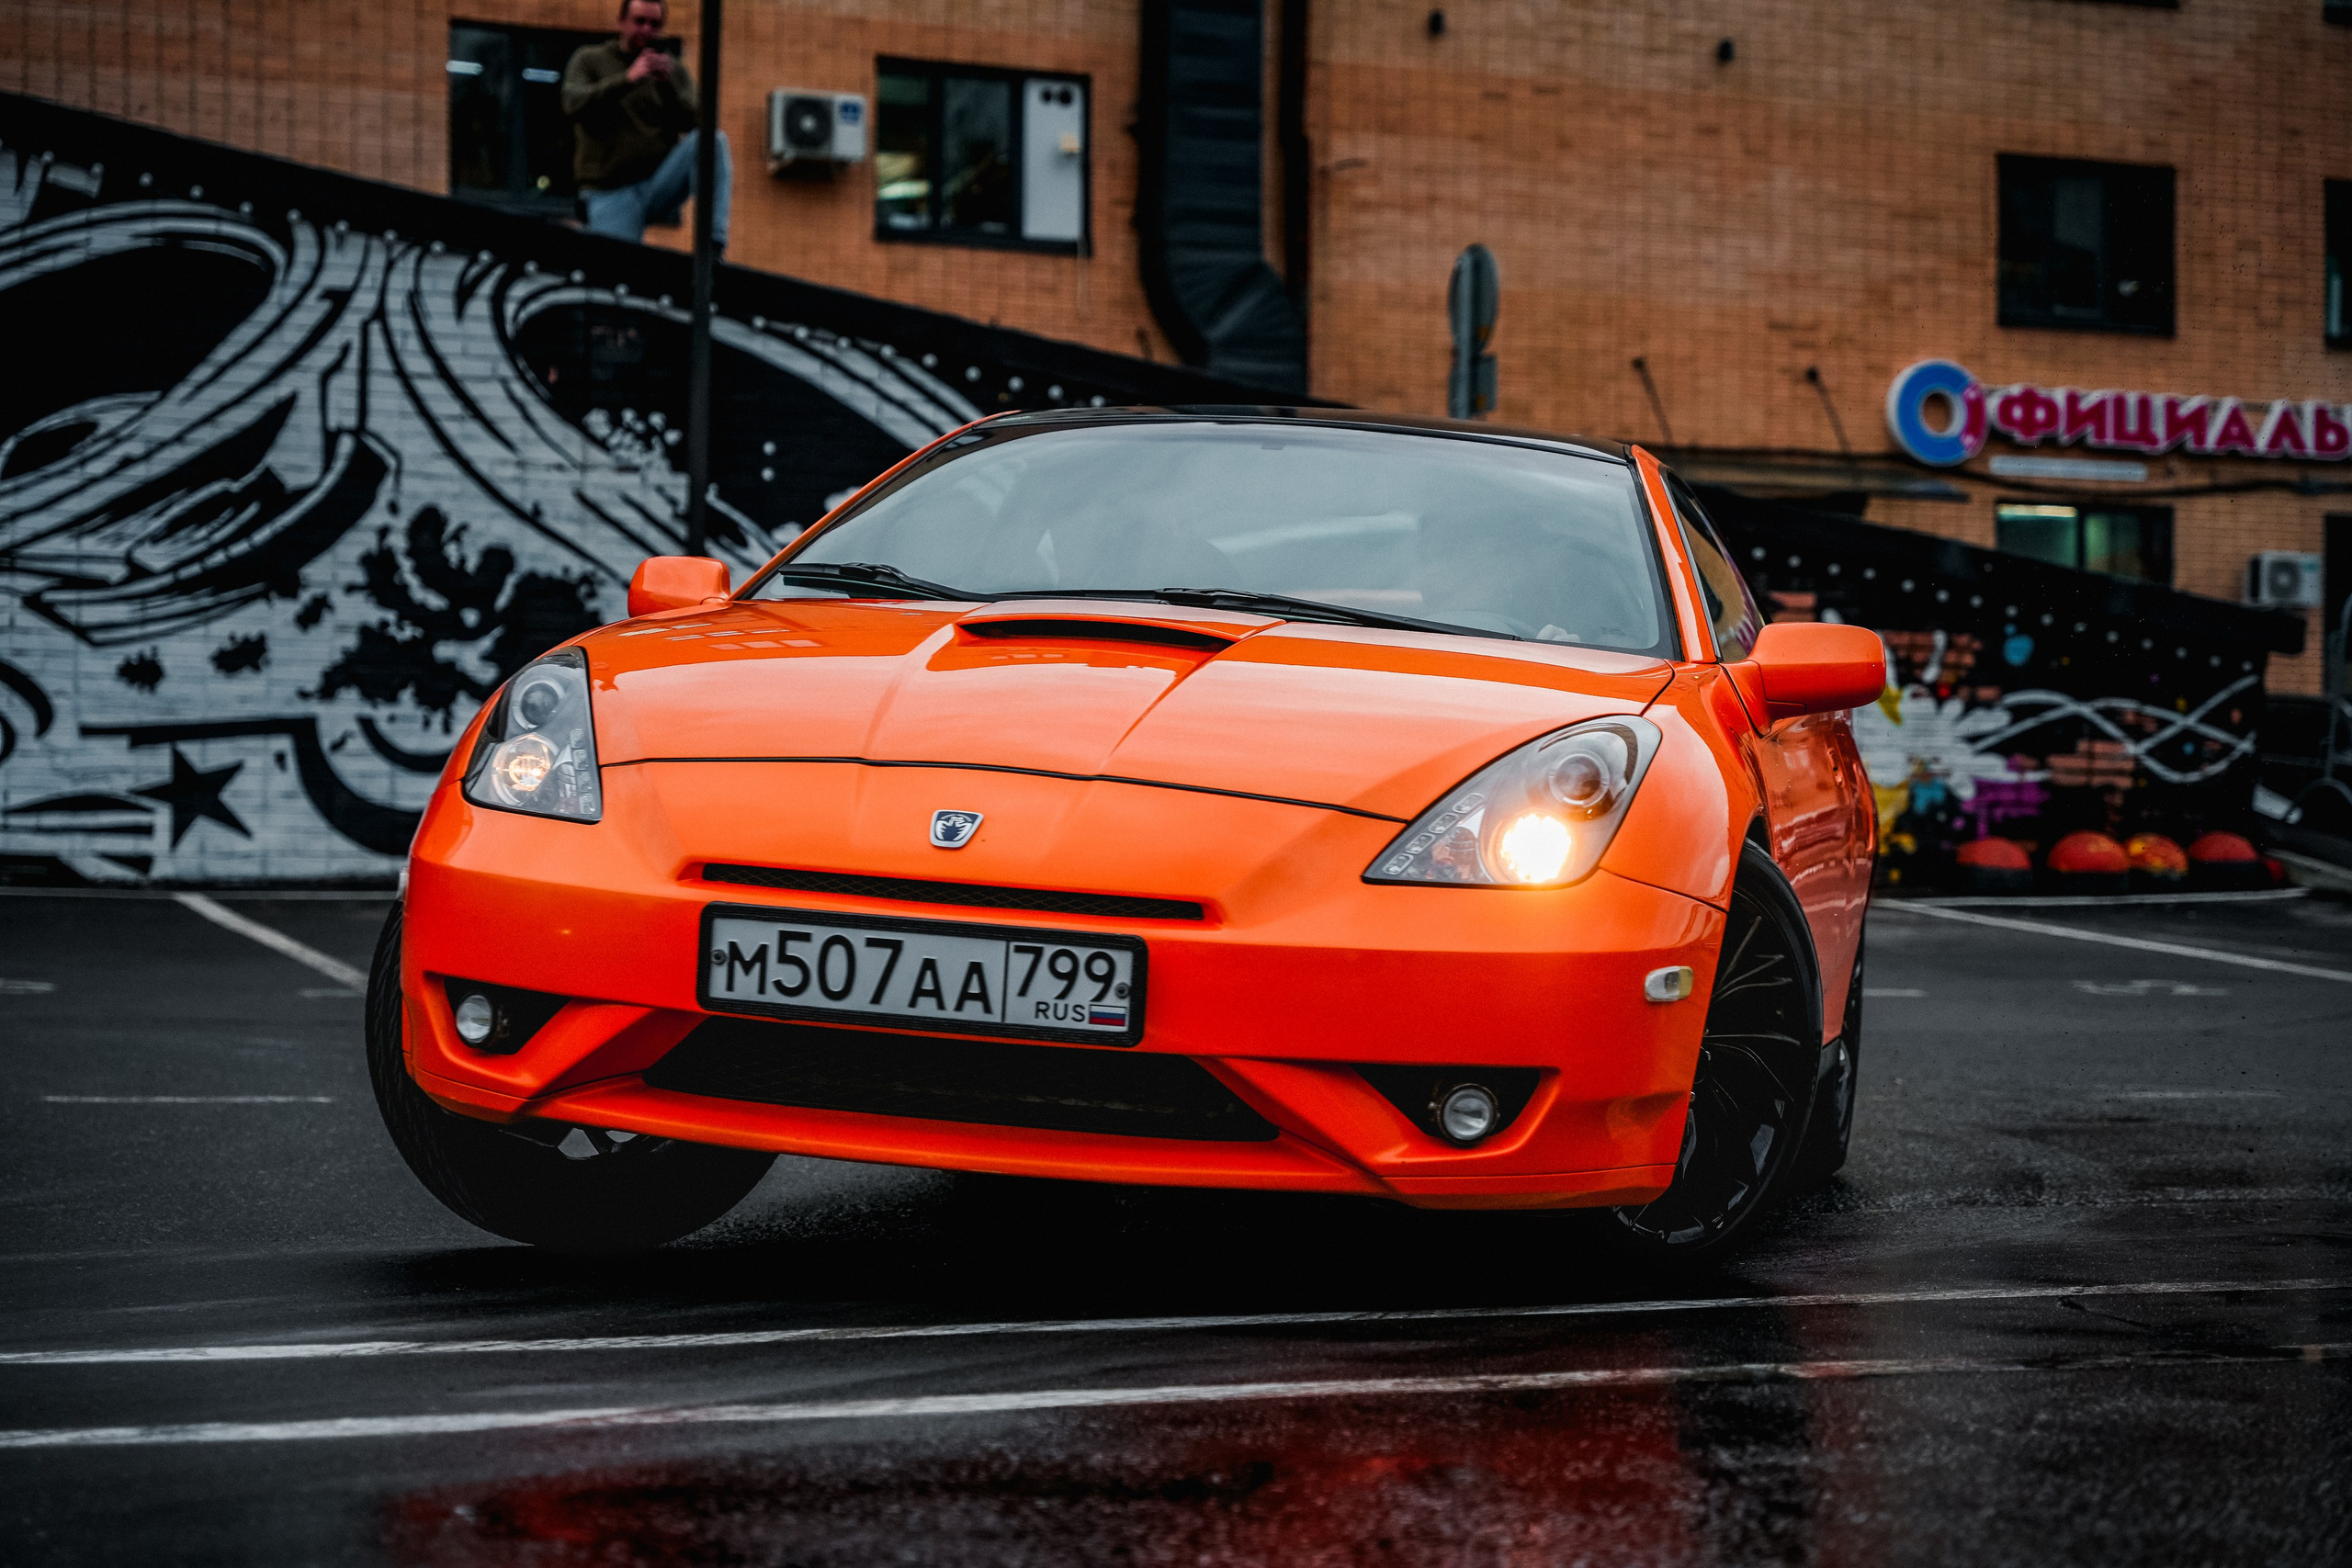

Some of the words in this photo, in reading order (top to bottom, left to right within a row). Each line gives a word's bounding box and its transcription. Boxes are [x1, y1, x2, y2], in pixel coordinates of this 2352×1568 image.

[1889, 359, 2352, 465] ОФИЦИАЛЬ
[1012, 945, 1116, 1002] 799
[1035, 1001, 1086, 1022] RUS
